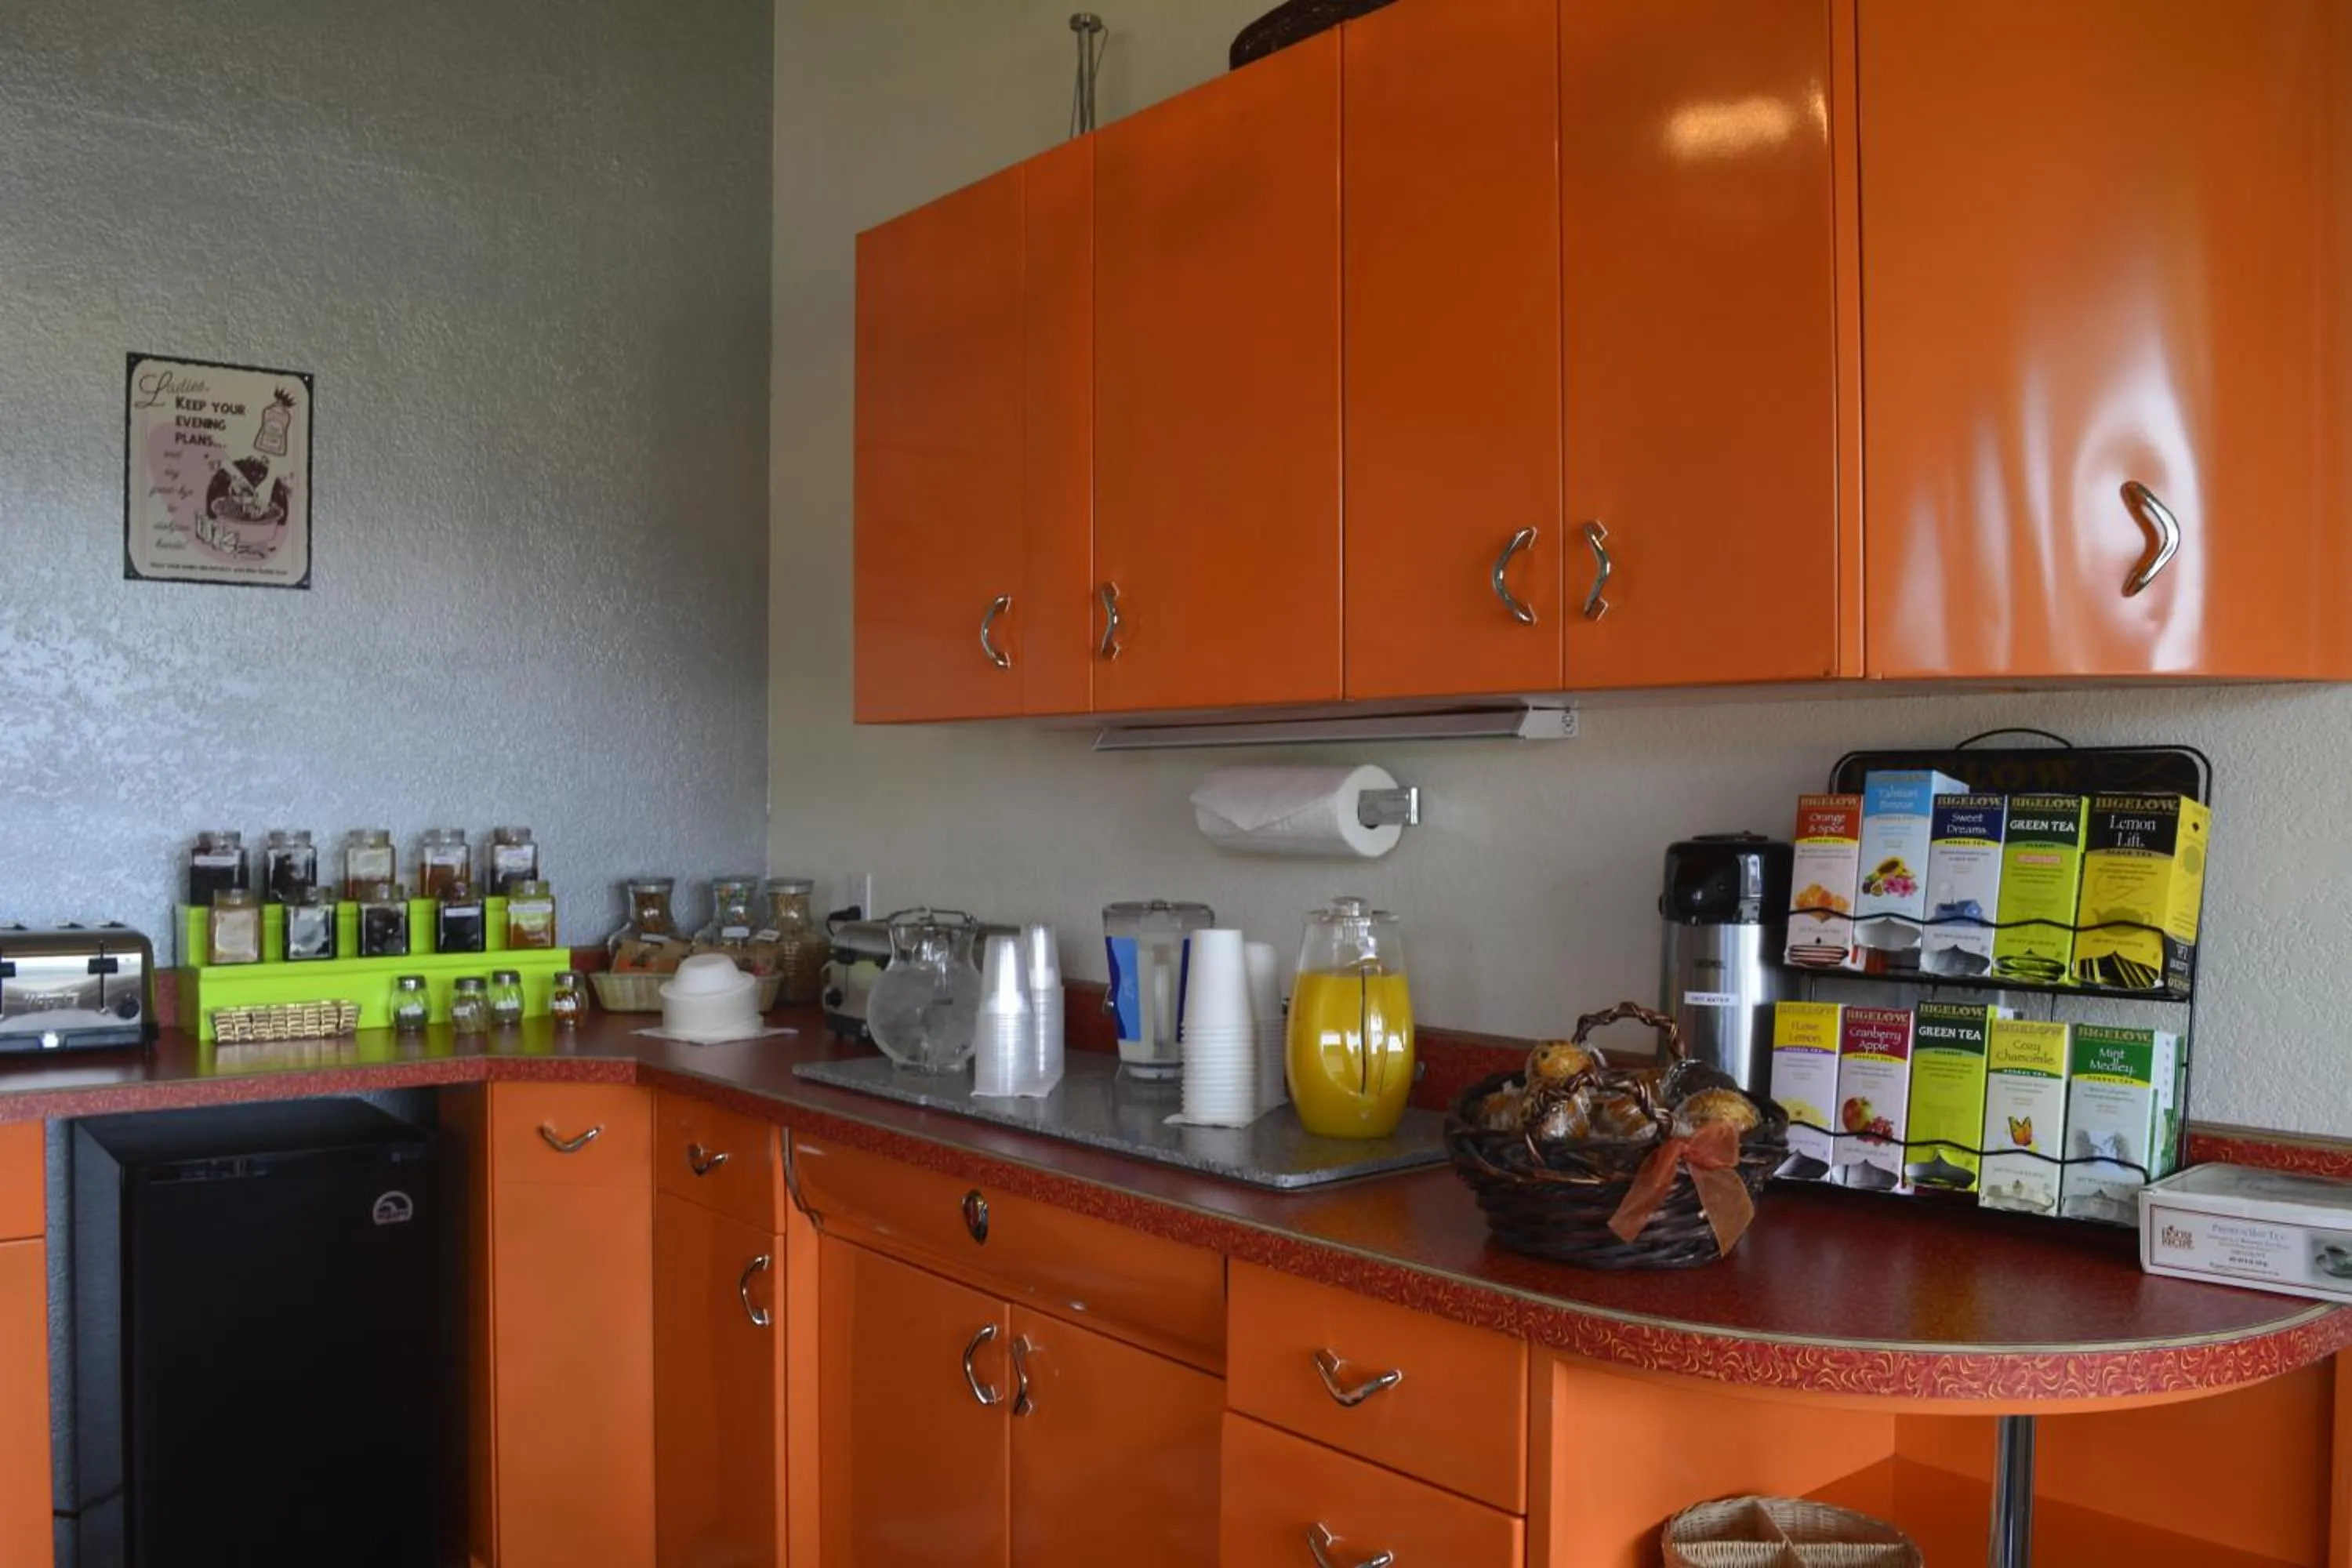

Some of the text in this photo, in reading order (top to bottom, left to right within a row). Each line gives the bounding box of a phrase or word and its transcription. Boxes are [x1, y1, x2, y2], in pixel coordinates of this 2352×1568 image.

[175, 396, 246, 415] KEEP YOUR
[175, 416, 226, 430] EVENING
[1801, 796, 1858, 809] BIGELOW
[1936, 795, 2003, 807] BIGELOW
[2011, 795, 2079, 808] BIGELOW
[2094, 797, 2179, 811] BIGELOW
[1809, 813, 1846, 826] Orange
[1951, 812, 1984, 823] Sweet
[2110, 814, 2156, 831] Lemon
[1817, 825, 1845, 837] Spice
[1946, 824, 1987, 836] Dreams
[2009, 820, 2075, 833] GREEN TEA
[1846, 1009, 1907, 1022] BIGELOW
[1920, 1002, 1985, 1017] BIGELOW
[1788, 1032, 1823, 1043] Lemon
[1849, 1025, 1902, 1045] Cranberry
[1918, 1025, 1982, 1041] GREEN TEA
[2078, 1026, 2151, 1043] BIGELOW
[1859, 1040, 1889, 1054] Apple
[2013, 1039, 2042, 1054] Cozy
[2098, 1047, 2125, 1058] Mint
[1996, 1048, 2056, 1065] Chamomile
[2089, 1058, 2134, 1077] Medley
